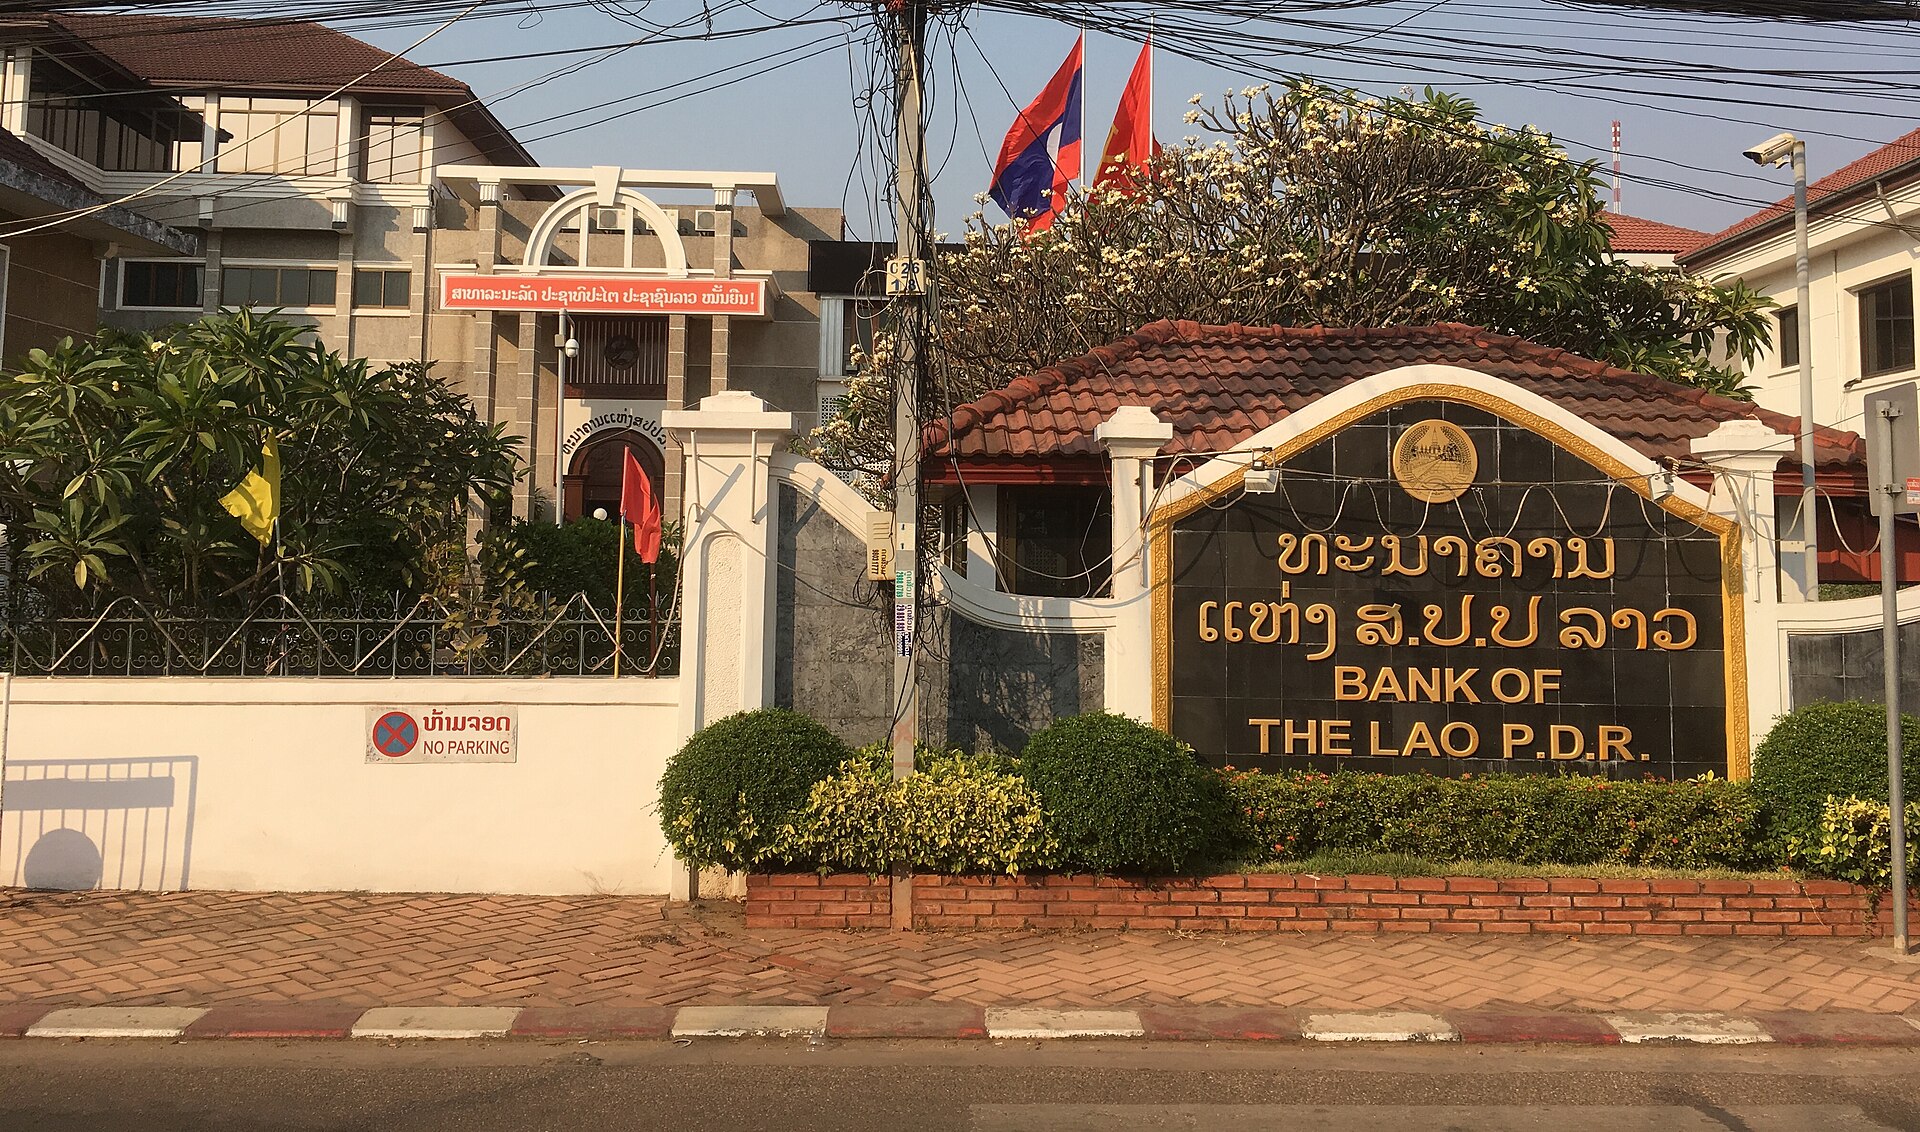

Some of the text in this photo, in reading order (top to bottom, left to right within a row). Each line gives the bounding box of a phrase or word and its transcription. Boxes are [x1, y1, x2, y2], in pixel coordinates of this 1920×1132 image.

[451, 284, 538, 302] ສາທາລະນະລັດ
[623, 288, 698, 308] ປະຊາຊົນລາວ
[1278, 533, 1616, 579] ທະນາຄານ
[1198, 581, 1699, 661] ແຫ່ງ ສ.ປ.ປ ລາວ
[1334, 666, 1563, 705] BANK OF
[422, 708, 511, 732] ຫ້າມຈອດ
[423, 741, 511, 755] NO PARKING
[1248, 718, 1652, 762] THE LAO P.D.R.
